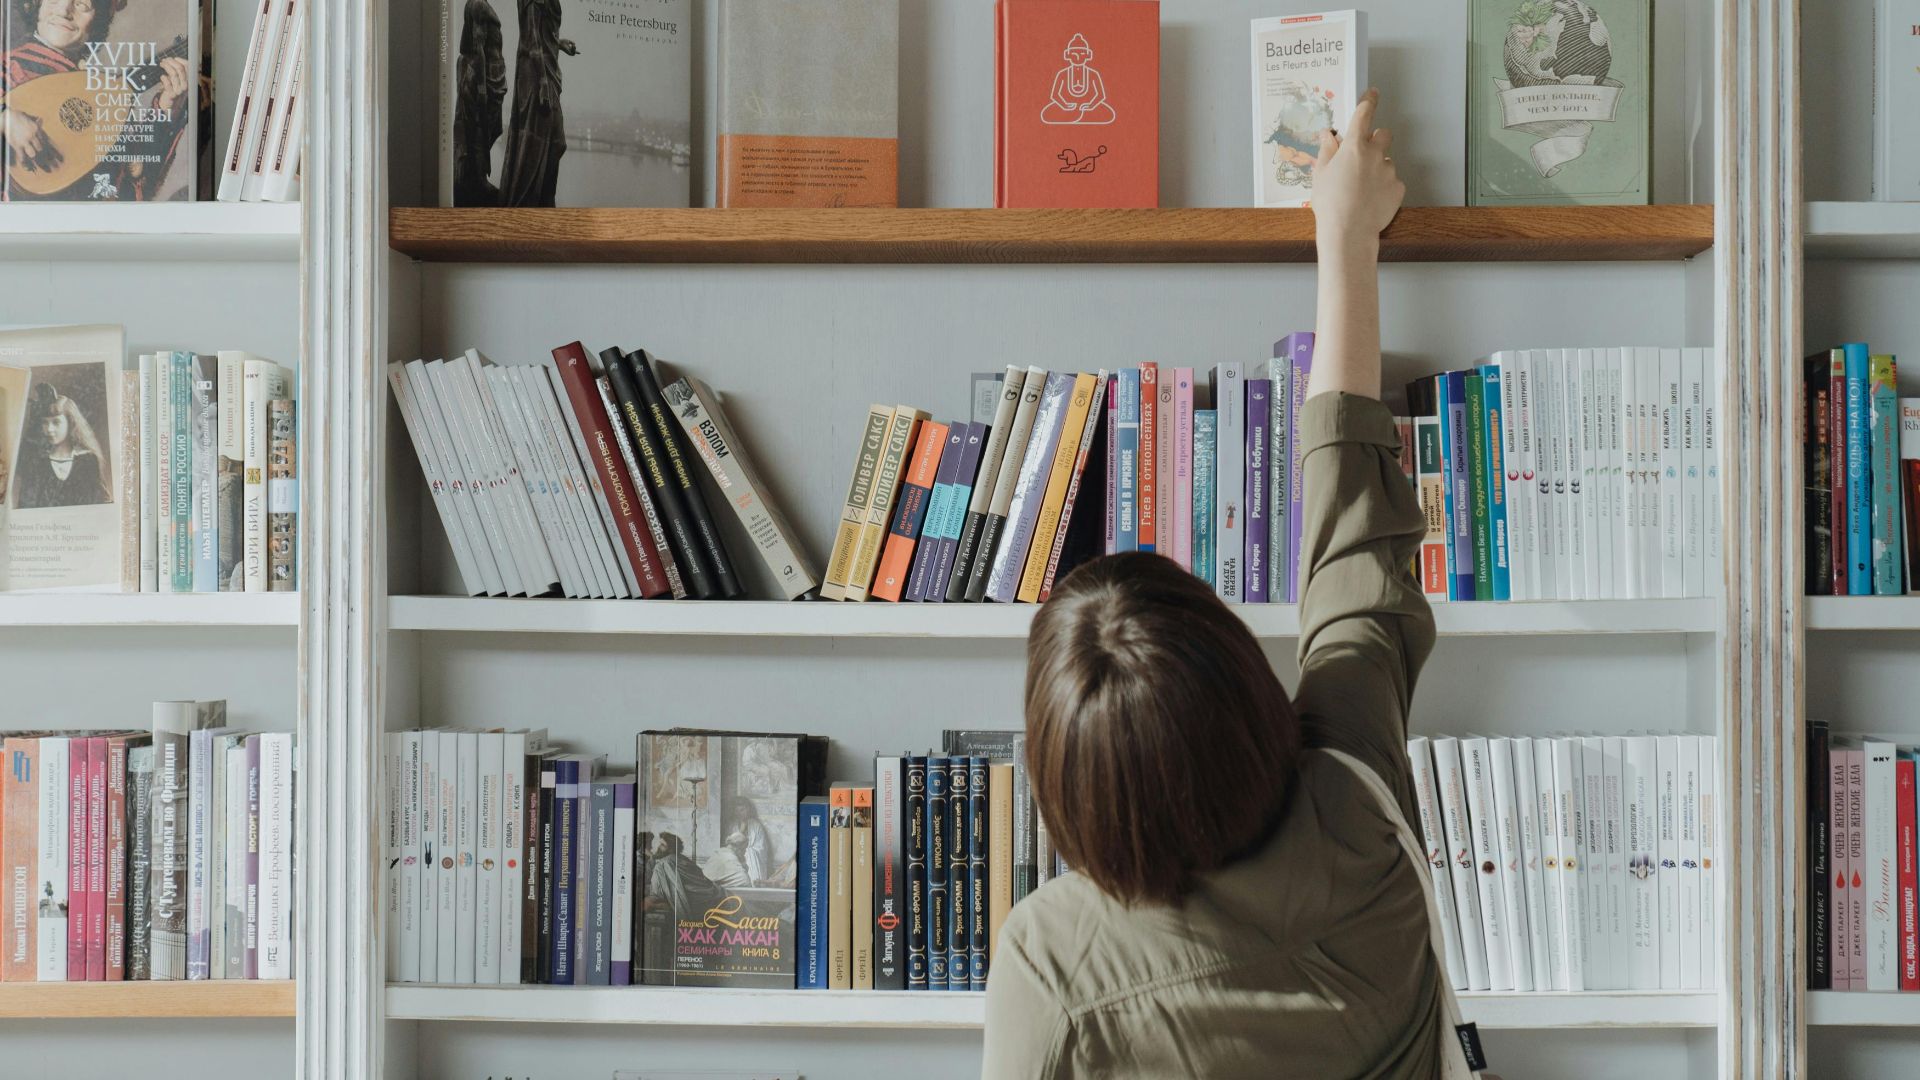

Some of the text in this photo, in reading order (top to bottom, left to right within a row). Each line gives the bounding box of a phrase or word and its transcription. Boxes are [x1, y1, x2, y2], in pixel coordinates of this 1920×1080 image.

[588, 10, 677, 35] Saint Petersburg
[1266, 38, 1343, 57] Baudelaire
[85, 42, 157, 66] XVIII
[85, 67, 147, 91] ВЕК:
[1266, 63, 1279, 71] Les
[1283, 61, 1308, 69] Fleurs
[1325, 57, 1339, 66] Mal
[95, 93, 142, 107] СМЕХ
[96, 108, 172, 122] И СЛЕЗЫ
[1514, 92, 1600, 104] ДЕНЕГ БОЛЬШЕ,
[1527, 106, 1548, 114] ЧЕМ
[1562, 105, 1587, 113] БОГА
[95, 155, 161, 163] ПРОСВЕЩЕНИЯ
[698, 418, 729, 460] ВЗЛОМ
[1144, 402, 1152, 480] отношениях
[1180, 400, 1188, 430] устала
[1455, 410, 1464, 473] Скрытые сокровища
[1849, 377, 1862, 478] СЯДЬТЕ НА ПОЛ
[176, 434, 186, 474] РОССИЮ
[624, 399, 666, 488] МИФЫ ДЛЯ ЖИЗНИ
[649, 401, 692, 489] МИФЫ ДЛЯ ЖИЗНИ
[852, 452, 875, 503] ОЛИВЕР
[866, 417, 885, 450] САКС
[875, 419, 908, 506] ОЛИВЕР САКС
[1122, 449, 1132, 488] КРИЗИСЕ
[1179, 432, 1188, 466] просто
[161, 466, 170, 517] САМИЗДАТ
[176, 477, 186, 515] ПОНЯТЬ
[591, 429, 633, 516] ПСИХОЛОГИЯ ВЕРЫ
[1178, 468, 1188, 477] Не
[1252, 427, 1263, 518] Рождение бабушки
[201, 479, 211, 560] ИЛЬЯ ШТЕМЛЕР
[898, 486, 916, 530] ПСИХОЛОГИЯ
[925, 484, 942, 534] ПЕРЕЛОМНЫЙ
[932, 505, 945, 535] МОМЕНТ
[1122, 501, 1132, 531] СЕМЬЯ
[1142, 497, 1151, 526] Гнев
[1457, 479, 1467, 536] Вайолет Оклендер
[248, 497, 259, 577] МЭРИ БИРД
[833, 526, 854, 582] ГАЛЛЮЦИНАЦИИ
[956, 512, 980, 577] Кей Джеймисон
[975, 513, 1000, 577] Кей Джеймисон
[1477, 524, 1487, 582] НАТАЛИЯ БЕЗУС
[249, 768, 257, 801] ГОРЕЧЬ
[1850, 764, 1861, 858] ОЧЕНЬ ЖЕНСКИЕ ДЕЛА
[73, 775, 81, 892] ПОЭМА ГОГОЛЯ «МЕРТВЫЕ ДУШИ»
[160, 743, 176, 919] С Тургеневым во Франции
[249, 814, 257, 853] ВОСТОРГ
[1834, 765, 1845, 859] ОЧЕНЬ ЖЕНСКИЕ ДЕЛА
[268, 741, 283, 941] Венедикт Ерофеев: посторонний
[559, 799, 570, 889] Пограничная личность
[934, 816, 943, 868] Эрих ФРОММ
[15, 867, 26, 928] ГЕРШЕНЗОН
[679, 896, 779, 930] Jacques Lacan
[810, 871, 818, 946] ПСИХОЛОГИЧЕСКИЙ
[913, 881, 922, 934] Эрих ФРОММ
[955, 881, 963, 934] Эрих ФРОММ
[975, 879, 983, 934] Эрих ФРОММ
[1871, 857, 1890, 922] Вагина
[557, 893, 568, 976] Натан Шварц-Салант
[678, 928, 779, 946] ЖАК ЛАКАН
[678, 947, 780, 959] СЕМИНАРЫ КНИГА 8
[877, 899, 900, 963] Зигмунд Фрейд
[1816, 891, 1824, 973] ЛИВ СТРЁМКВИСТ
[1853, 900, 1861, 956] ДЖЕК ПАРКЕР
[1905, 887, 1916, 979] СЕКС, ВОДКА, ПОТАНЦУЕМ?
[809, 949, 817, 983] КРАТКИЙ
[835, 950, 844, 981] ФРЕЙД
[858, 949, 866, 980] ФРЕЙД
